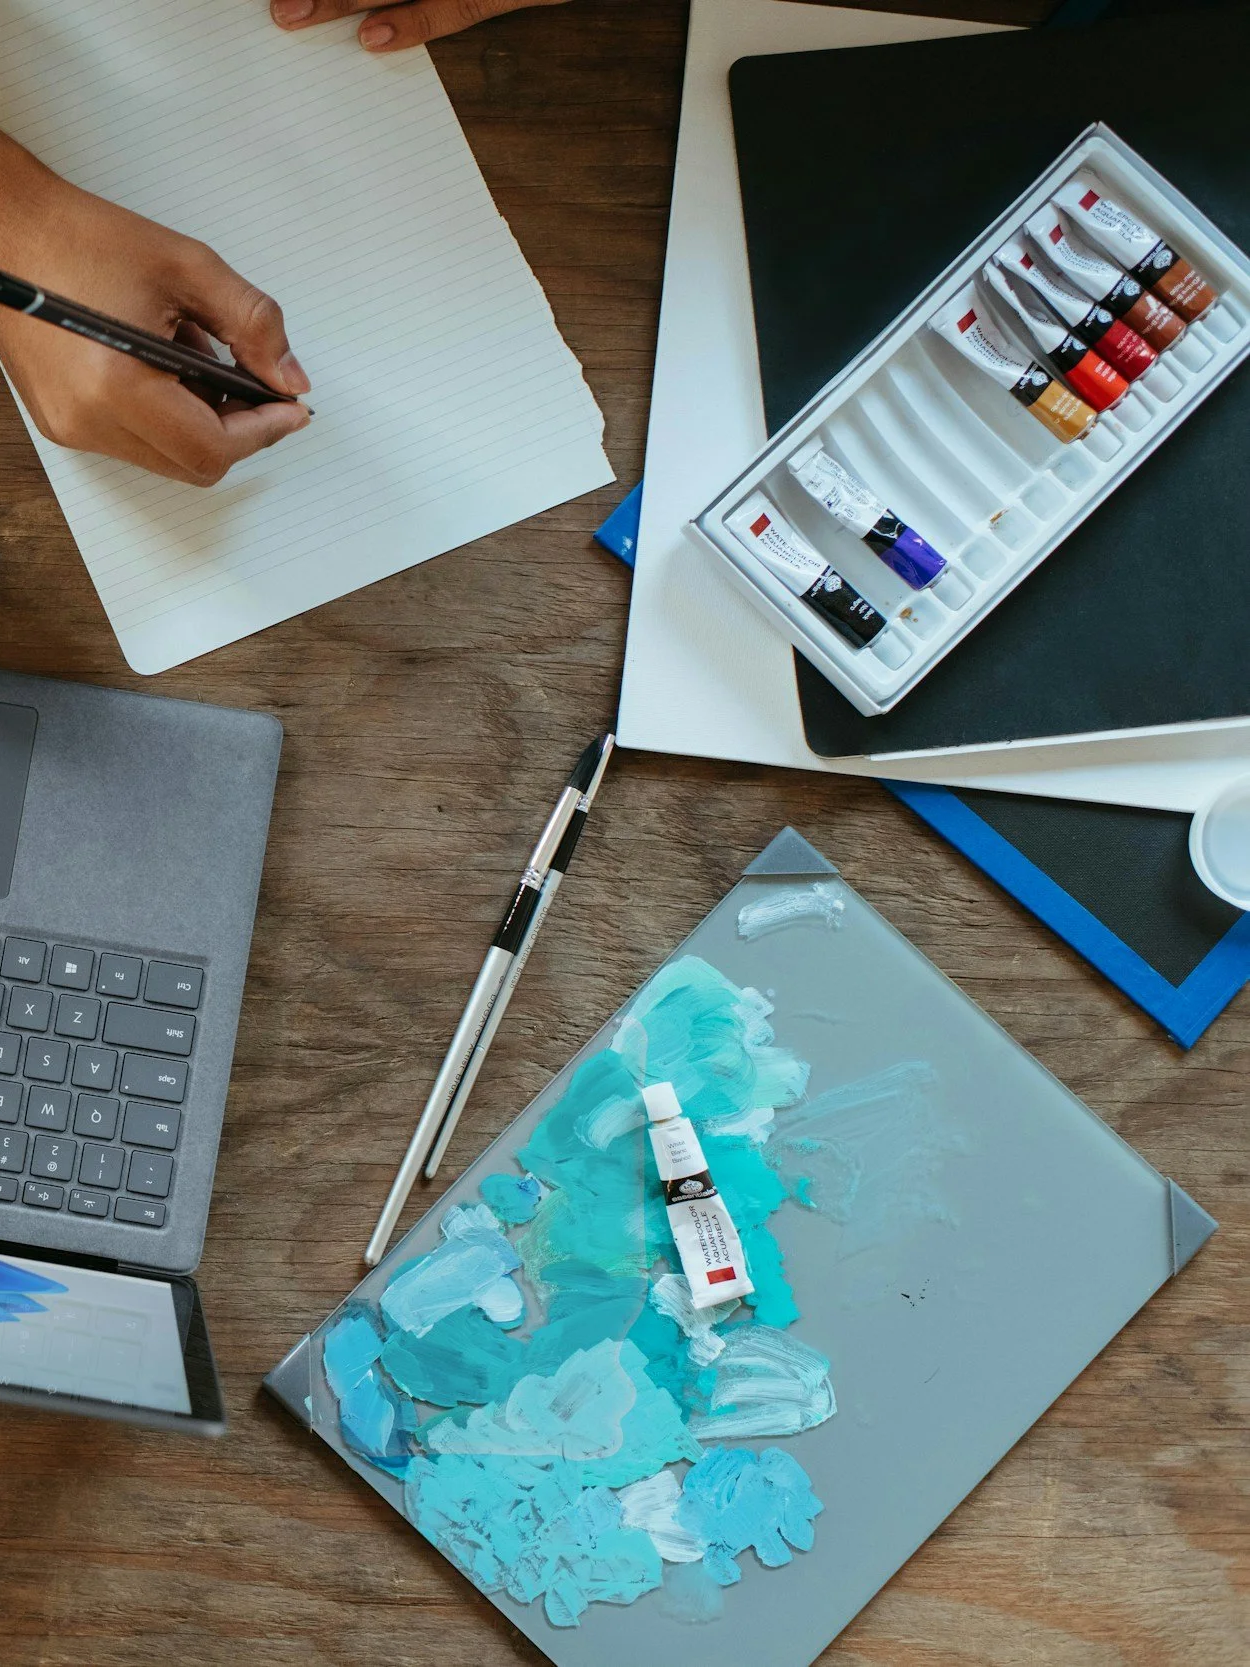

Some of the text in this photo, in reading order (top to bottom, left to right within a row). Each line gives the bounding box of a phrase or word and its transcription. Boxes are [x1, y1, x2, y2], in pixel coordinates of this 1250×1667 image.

[18, 956, 31, 965] Alt
[114, 971, 125, 981] Fn
[177, 982, 192, 991] Ctrl
[25, 1003, 35, 1016] X
[73, 1011, 83, 1024] Z
[166, 1028, 185, 1038] Shift
[42, 1054, 51, 1066] S
[90, 1062, 101, 1074] A
[158, 1074, 177, 1085] Caps
[40, 1103, 55, 1116] W
[90, 1109, 102, 1124] Q
[155, 1123, 169, 1133] Tab
[3, 1137, 11, 1148] 3
[51, 1145, 59, 1156] 2
[0, 1155, 8, 1165] #
[100, 1153, 106, 1164] 1
[46, 1161, 58, 1172] @
[98, 1169, 103, 1180] !
[143, 1209, 156, 1219] Esc
[688, 1205, 712, 1267] WATERCOLOR
[700, 1211, 722, 1264] AQUARELLE
[711, 1214, 730, 1262] ACUARELA
